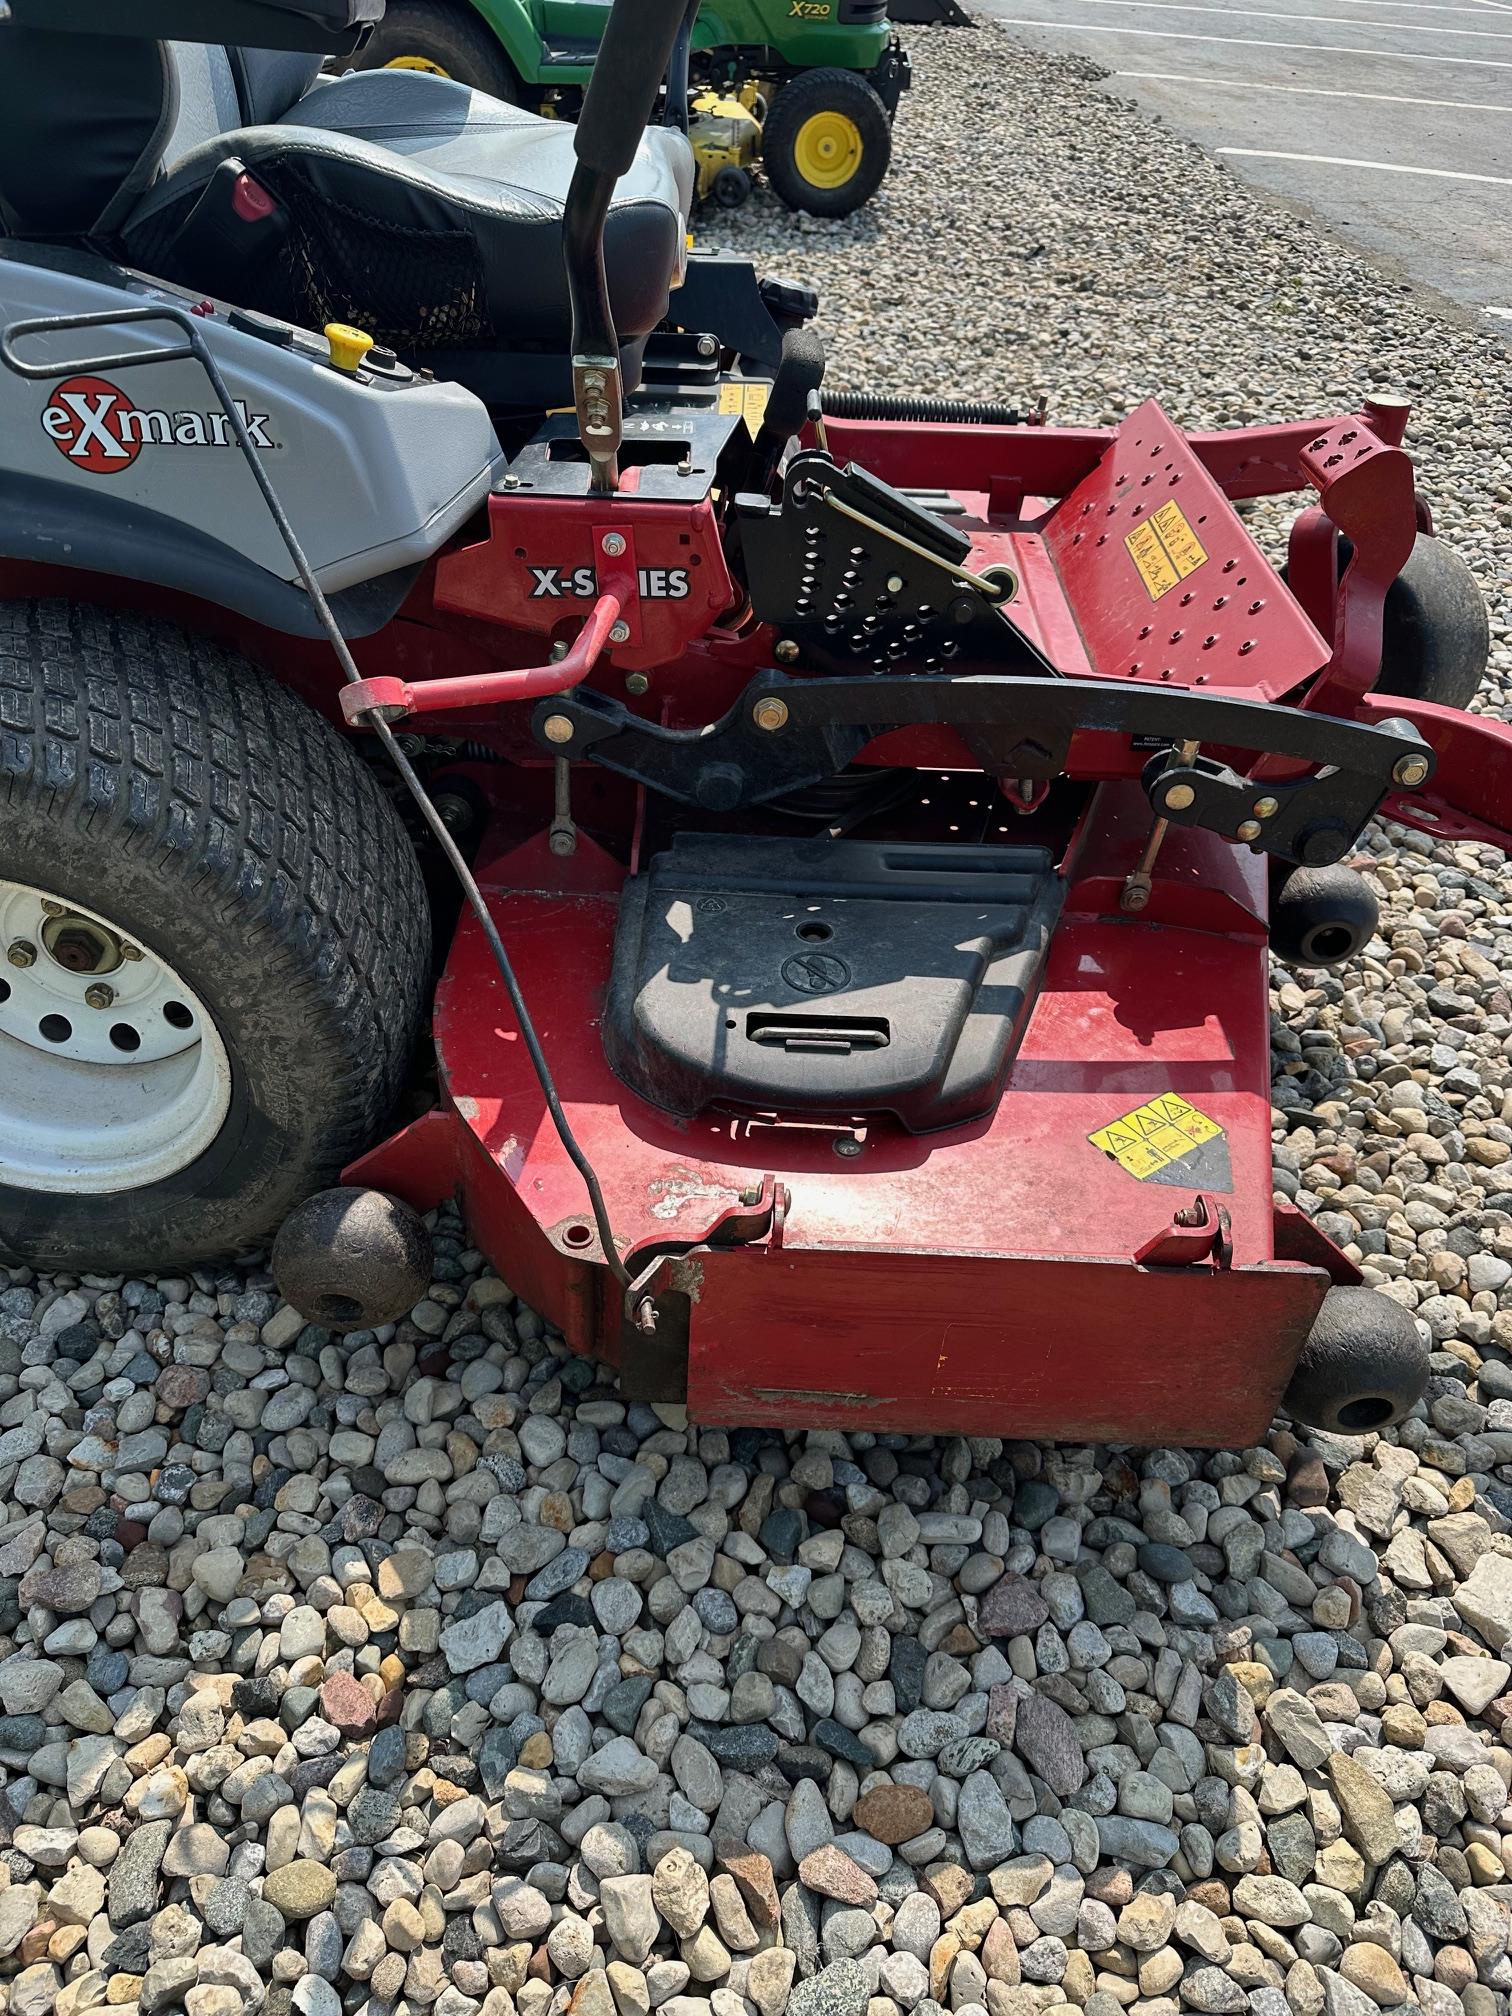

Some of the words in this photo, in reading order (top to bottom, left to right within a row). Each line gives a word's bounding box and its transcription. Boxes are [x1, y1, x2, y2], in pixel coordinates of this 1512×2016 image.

[788, 1, 831, 16] X720
[42, 392, 274, 458] eXmark
[531, 568, 690, 599] X-SIES
